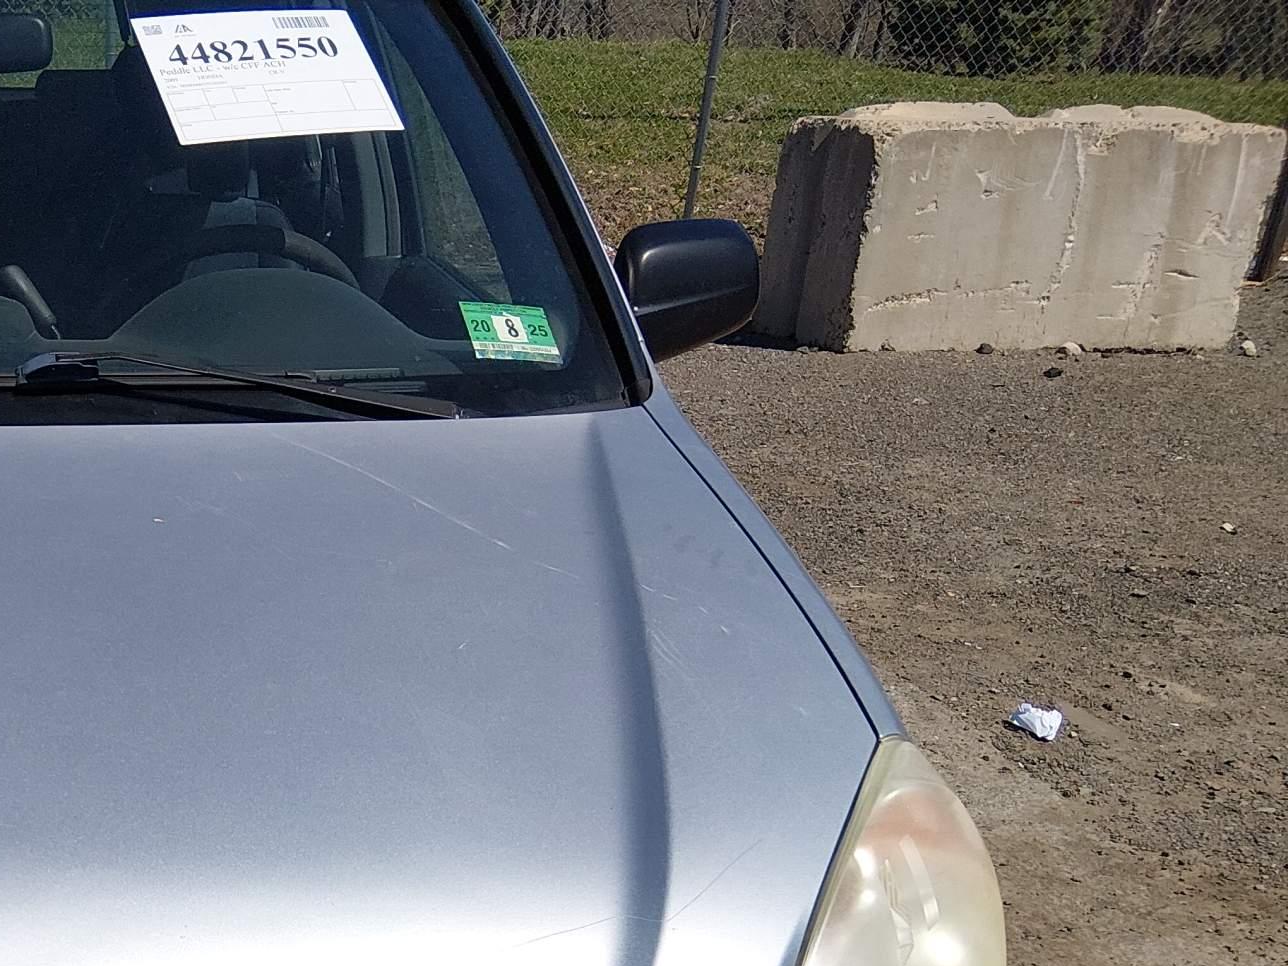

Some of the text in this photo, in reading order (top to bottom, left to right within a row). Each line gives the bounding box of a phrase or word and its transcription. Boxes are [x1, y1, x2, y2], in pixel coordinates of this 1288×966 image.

[169, 36, 338, 65] 44821550
[159, 67, 191, 76] Peddle
[192, 65, 213, 73] LLC
[471, 318, 549, 338] 20 8 25
